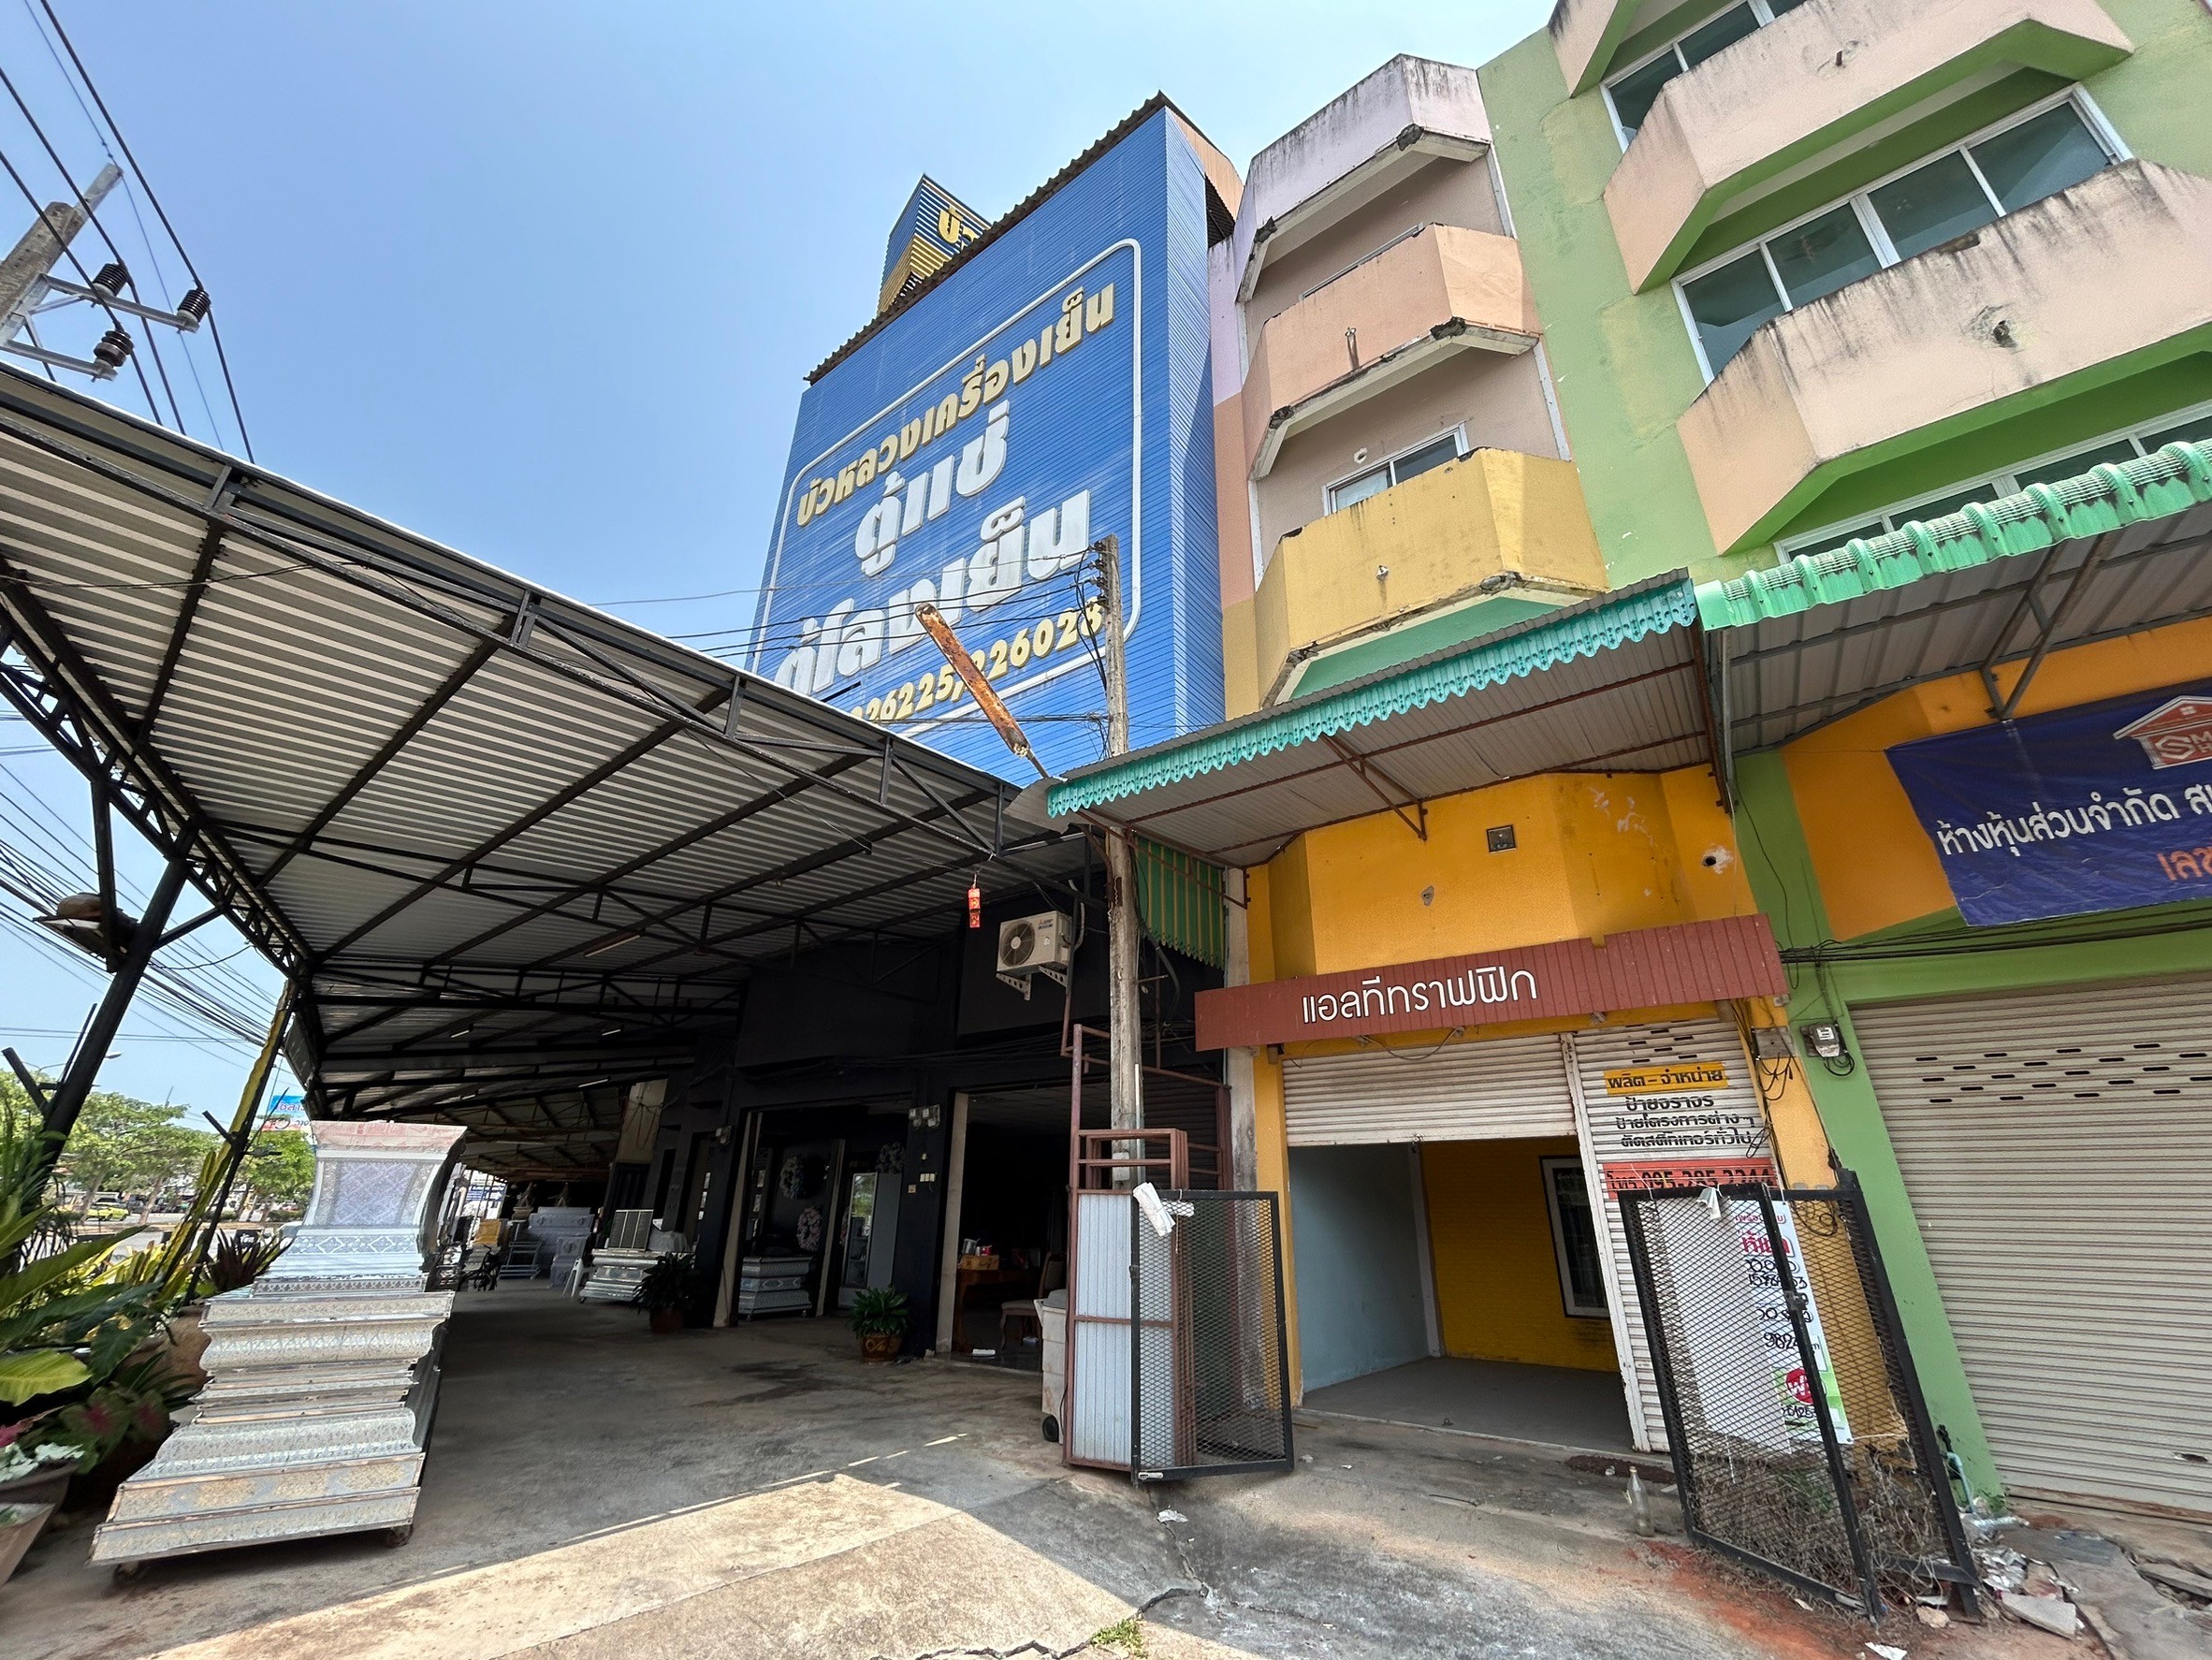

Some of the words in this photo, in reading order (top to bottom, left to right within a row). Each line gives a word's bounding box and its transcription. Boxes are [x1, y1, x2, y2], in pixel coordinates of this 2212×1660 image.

[797, 283, 1114, 527] บัวหลวงเครื่องเย็น
[854, 400, 1011, 576] ตู้แช่
[774, 489, 1091, 695] ต้โลงเย็น
[1936, 786, 2180, 857] ห้างหุ้นส่วนจำกัด
[1302, 965, 1537, 1025] แอลทีทราฟฟิก
[1607, 1072, 1646, 1089] ผลิต
[1660, 1066, 1724, 1085] จำหน่าย
[1625, 1095, 1715, 1112] ป้ายจราจร
